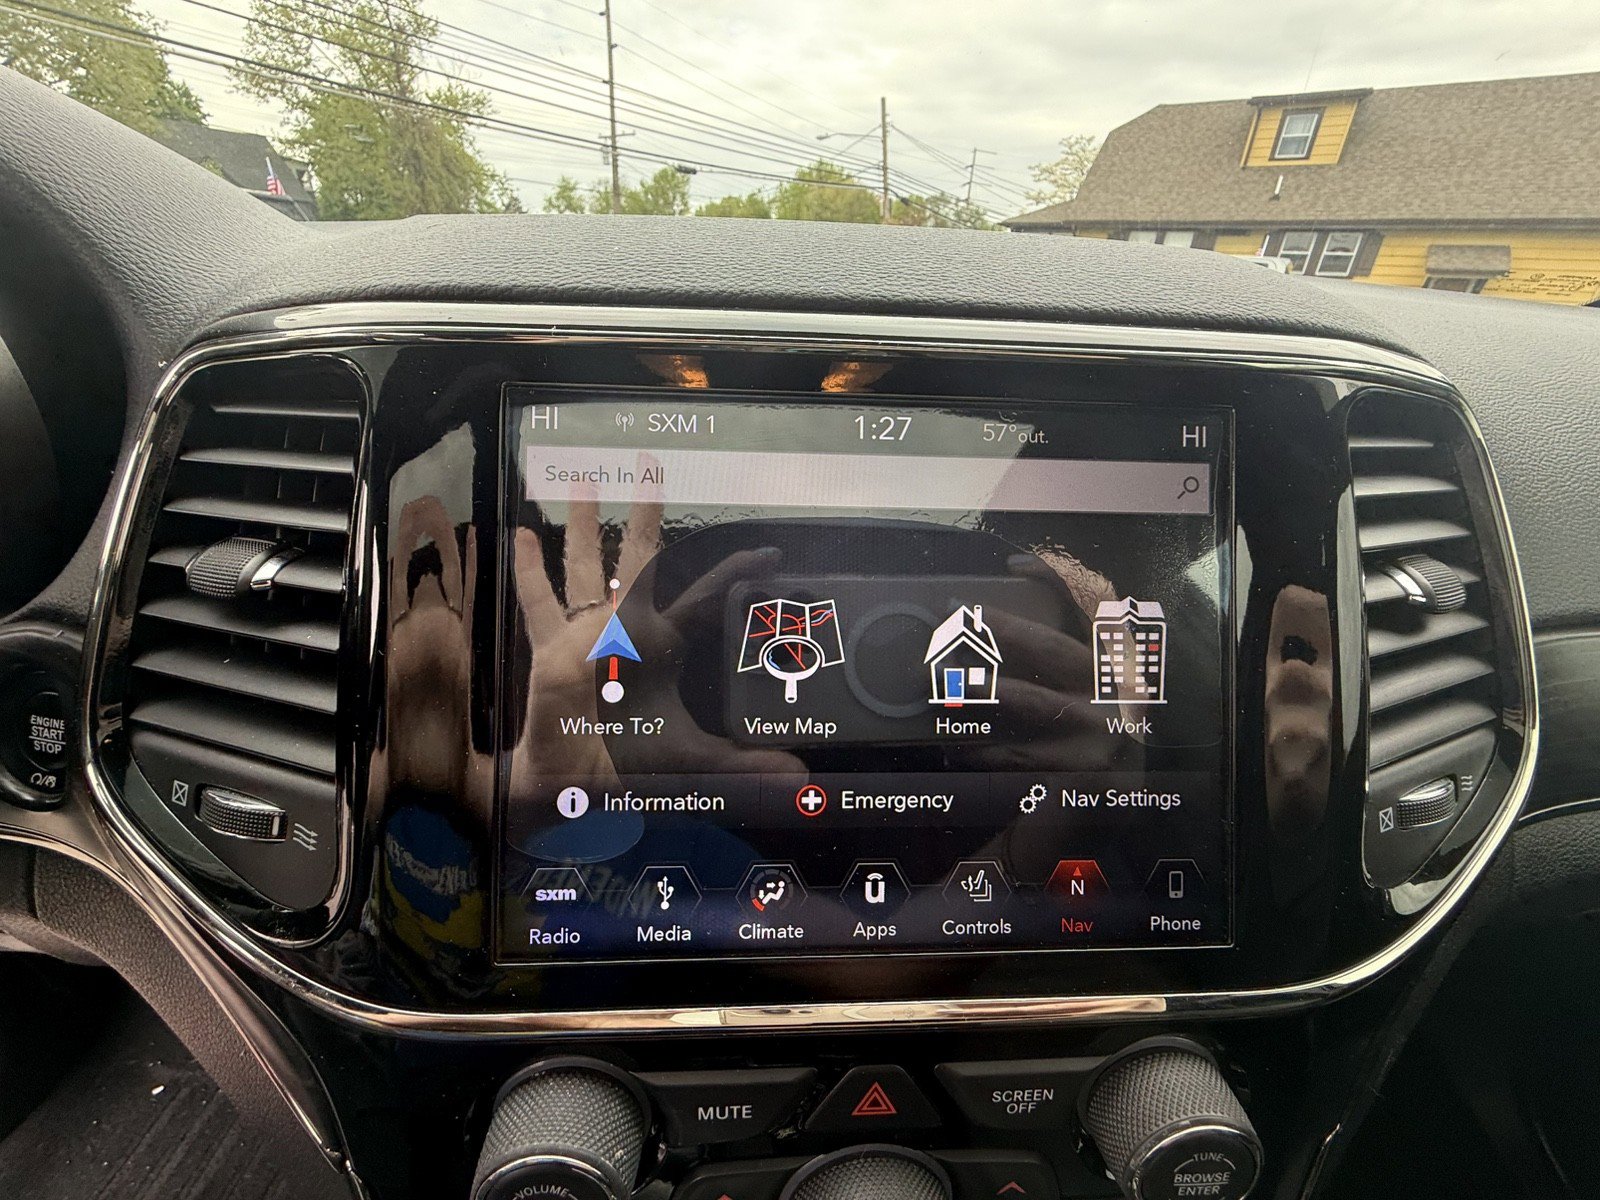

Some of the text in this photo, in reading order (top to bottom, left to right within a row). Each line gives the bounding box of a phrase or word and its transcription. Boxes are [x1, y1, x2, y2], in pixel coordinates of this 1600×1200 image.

[531, 406, 559, 430] HI
[647, 413, 715, 433] SXM 1
[854, 416, 912, 440] 1:27
[1182, 425, 1207, 448] HI
[545, 465, 664, 484] Search In All
[30, 714, 65, 729] ENGINE
[560, 717, 665, 735] Where To?
[744, 717, 837, 738] View Map
[936, 717, 992, 735] Home
[1106, 717, 1153, 735] Work
[31, 726, 64, 740] START
[33, 740, 62, 754] STOP
[604, 791, 725, 812] Information
[841, 790, 954, 812] Emergency
[1061, 789, 1181, 811] Nav Settings
[738, 922, 805, 941] Climate
[853, 922, 897, 940] Apps
[942, 919, 1012, 936] Controls
[1061, 919, 1093, 933] Nav
[1150, 916, 1202, 932] Phone
[529, 928, 581, 945] Radio
[637, 925, 692, 943] Media
[991, 1088, 1055, 1104] SCREEN
[697, 1104, 753, 1122] MUTE
[1006, 1102, 1037, 1115] OFF
[1193, 1151, 1225, 1162] TUNE
[1174, 1171, 1231, 1183] BROWSE
[515, 1184, 570, 1199] VOLUME
[1178, 1185, 1220, 1196] ENTER
